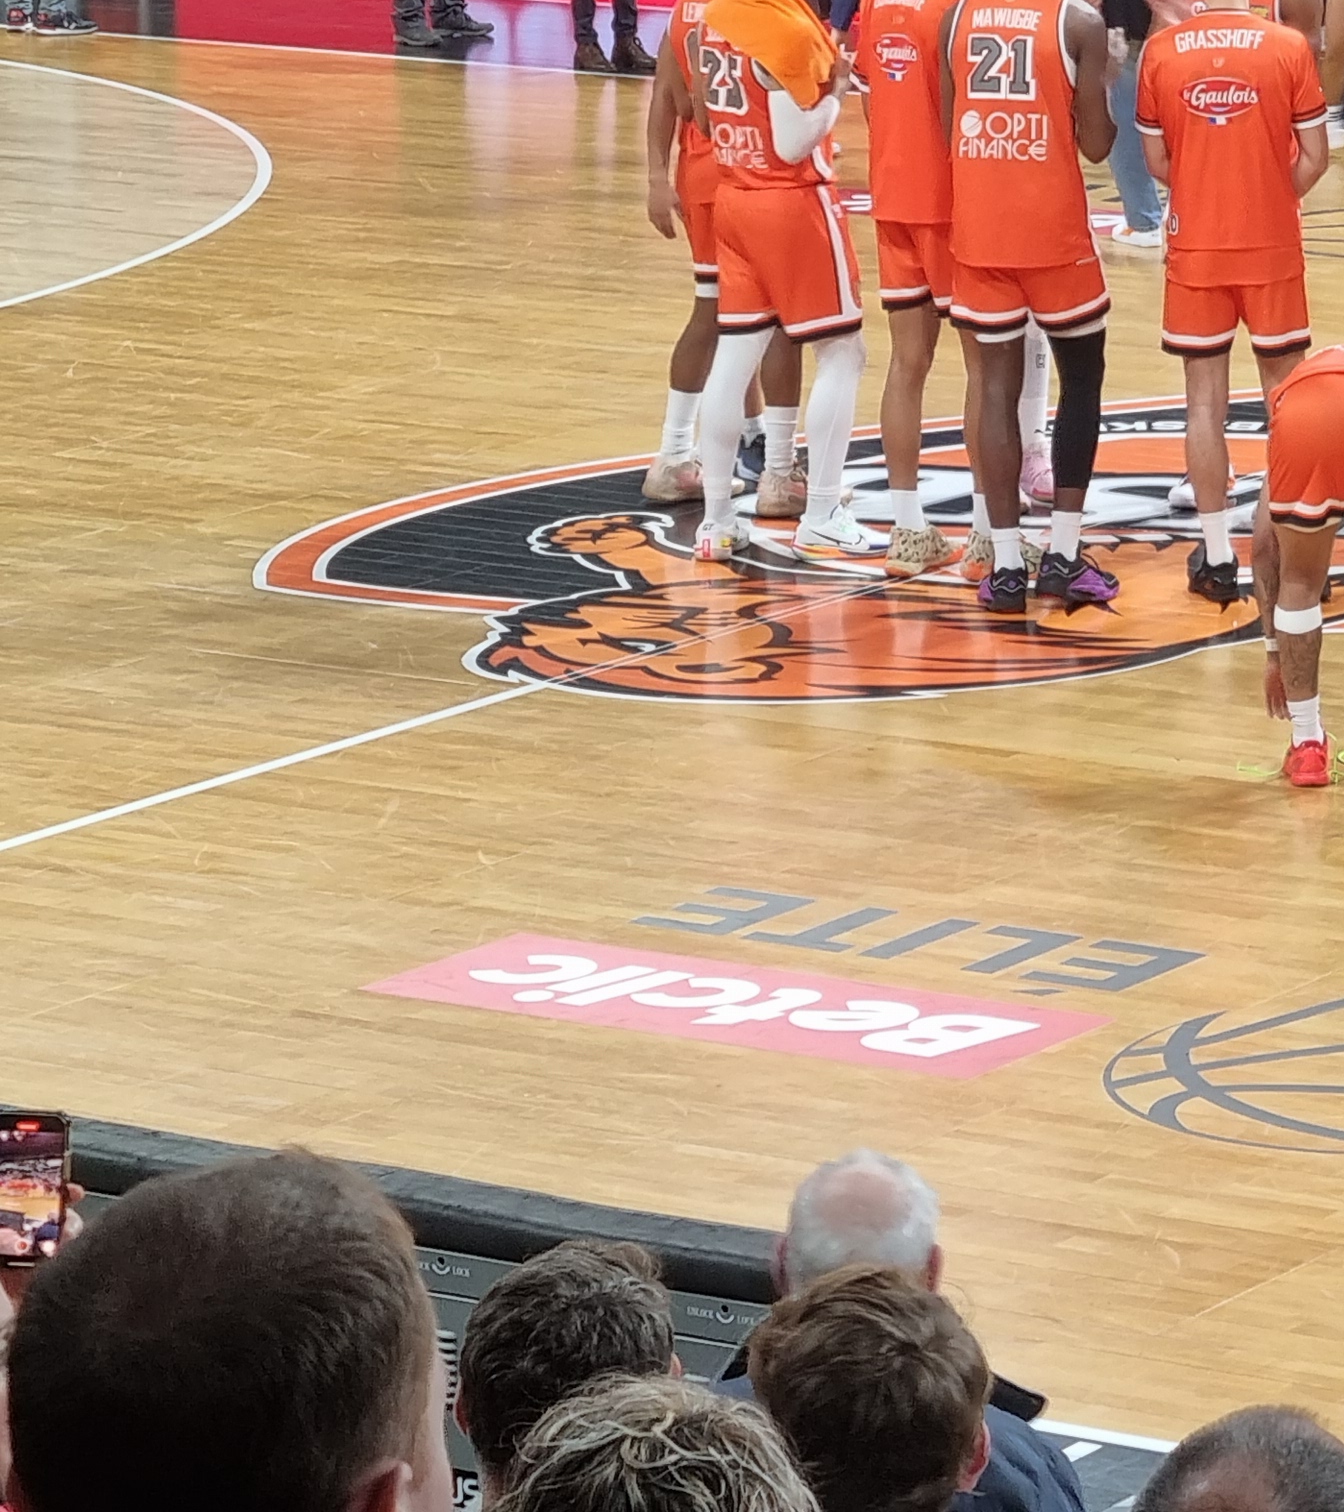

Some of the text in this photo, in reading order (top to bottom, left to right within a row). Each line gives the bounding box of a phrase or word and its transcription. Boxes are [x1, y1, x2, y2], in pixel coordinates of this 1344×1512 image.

[972, 8, 1043, 31] MAWUGBE
[1174, 28, 1266, 53] GRASSHOFF
[967, 33, 1037, 100] 21
[1190, 84, 1259, 110] Gaulois
[985, 111, 1048, 140] OPTI
[468, 953, 1043, 1059] Betclic
